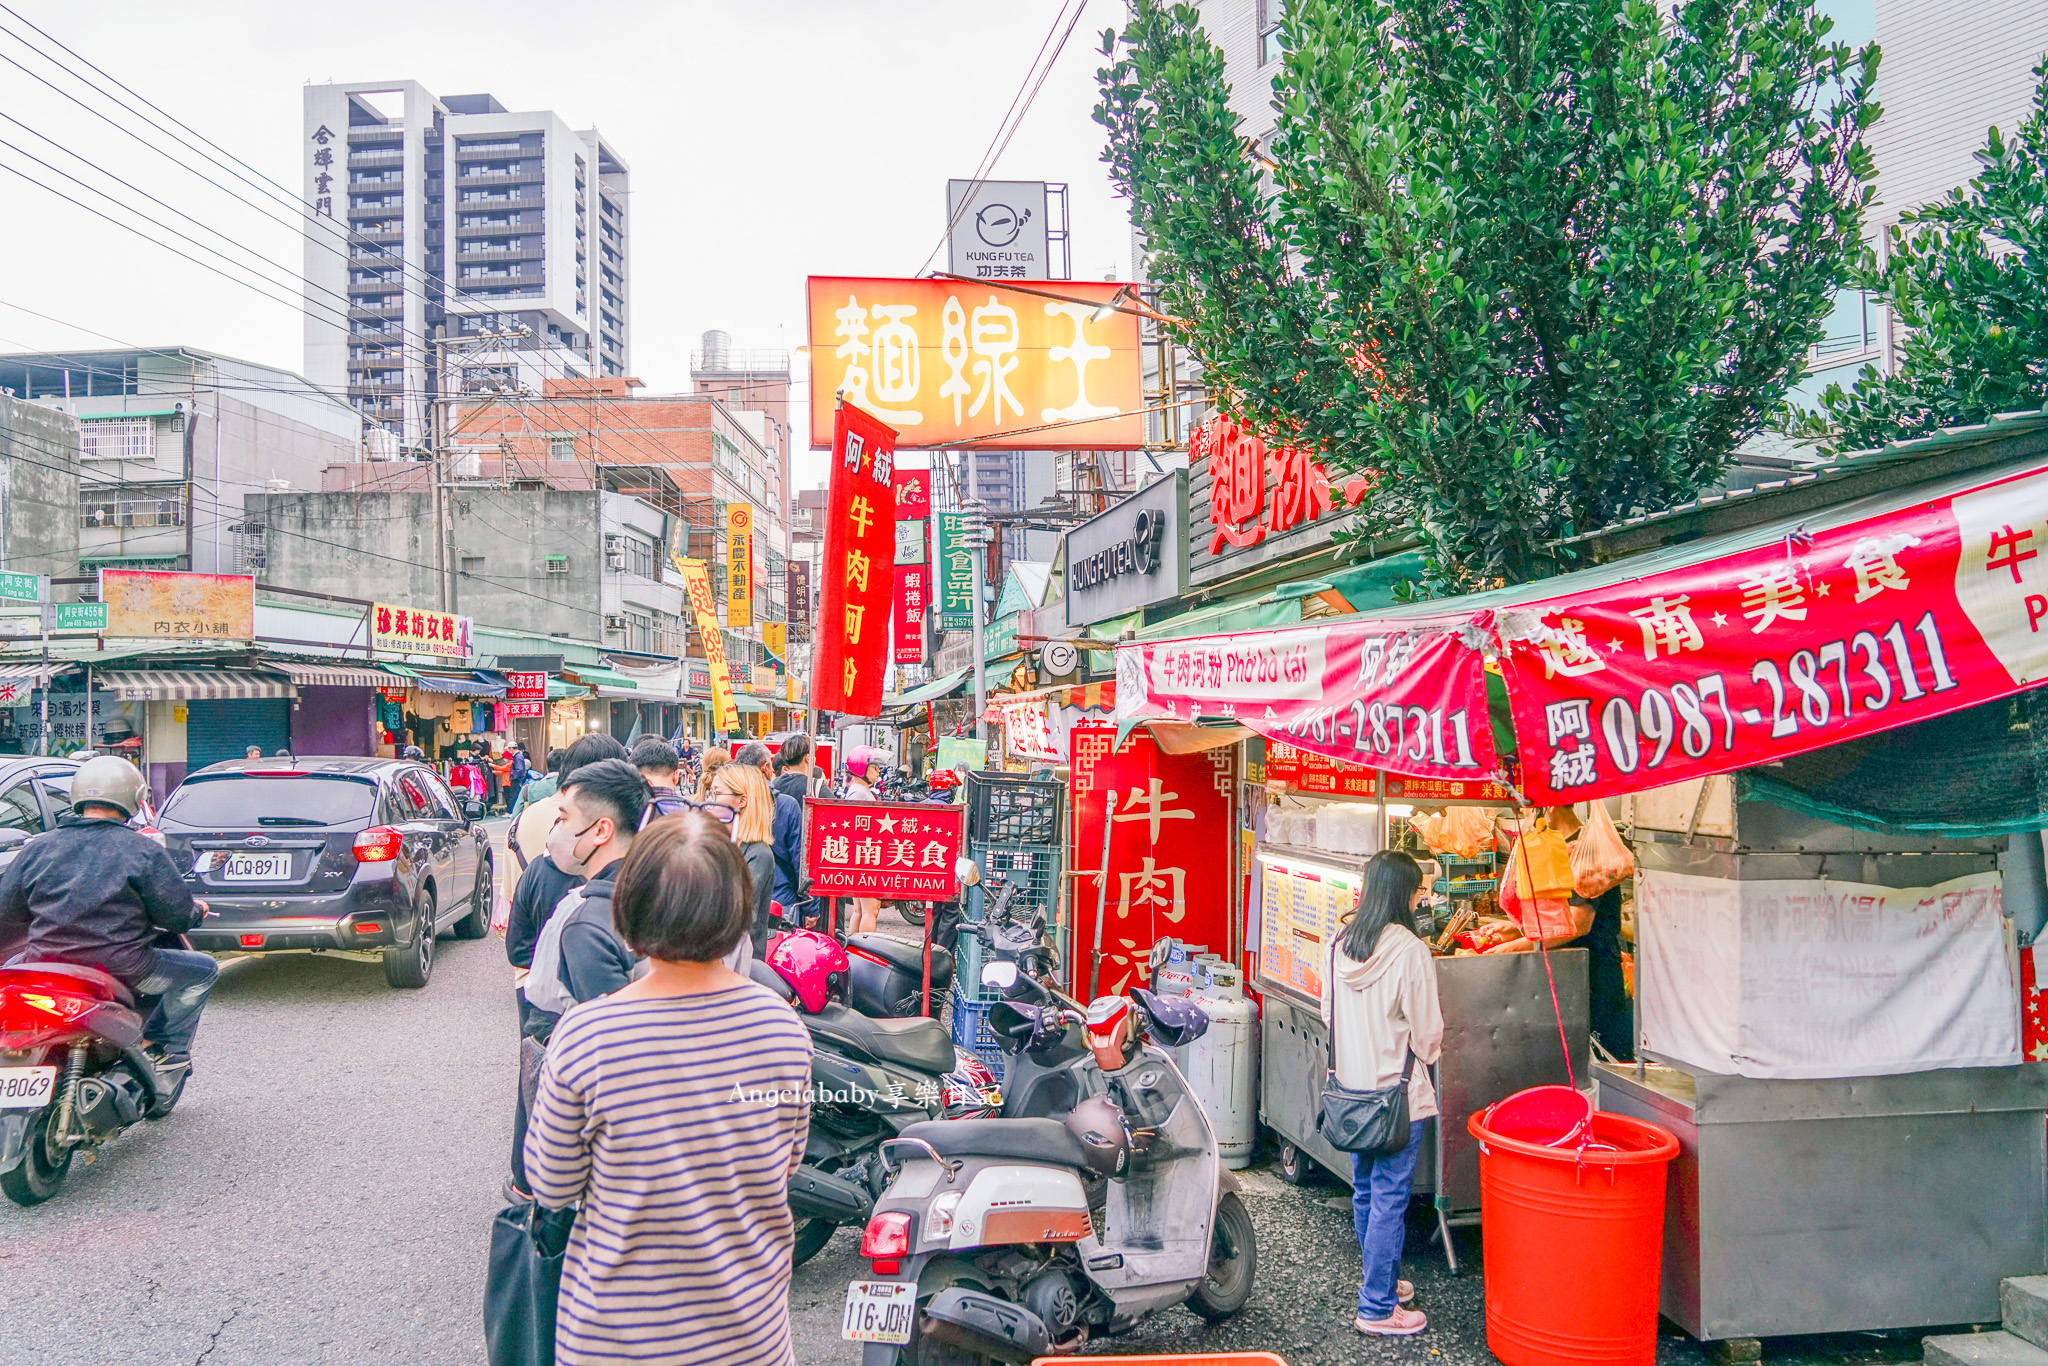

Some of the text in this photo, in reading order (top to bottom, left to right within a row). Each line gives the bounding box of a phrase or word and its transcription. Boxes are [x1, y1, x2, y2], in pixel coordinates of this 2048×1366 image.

[966, 251, 1035, 261] KUNG FU TEA
[976, 264, 1026, 278] 功夫茶
[835, 294, 1122, 427] 麵線王
[1208, 411, 1377, 556] 麵線
[732, 534, 746, 600] 永慶不動產
[1072, 538, 1133, 591] KUNG FU TEA
[4, 574, 33, 590] 同安街
[904, 572, 921, 623] 蝦捲飯
[1544, 532, 1915, 679] 越南美食
[64, 605, 104, 618] 同安街455巷
[64, 619, 74, 628] Lane
[73, 619, 82, 628] 455
[154, 620, 229, 635] 內衣小舖
[376, 606, 454, 642] 珍柔坊女裝
[1163, 648, 1223, 689] 牛肉河粉
[1284, 644, 1308, 684] tái
[0, 682, 17, 702] 米
[508, 674, 544, 690] 修改衣服
[1601, 609, 1960, 776] 0987-287311
[18, 722, 48, 739] 新品
[1009, 706, 1058, 755] 麵線王
[1545, 699, 1598, 790] 阿絨
[1403, 779, 1450, 792] 涼拌木瓜蝦仁
[1452, 784, 1463, 793] 75
[1481, 783, 1523, 798] 米食
[855, 814, 919, 834] 阿絨
[820, 835, 949, 869] 越南美食
[226, 860, 288, 876] ACQ-8911
[820, 872, 945, 890] MÓN ĂN VIỆT NAM
[0, 1077, 50, 1098] -8069
[846, 1301, 912, 1334] 116-JDH
